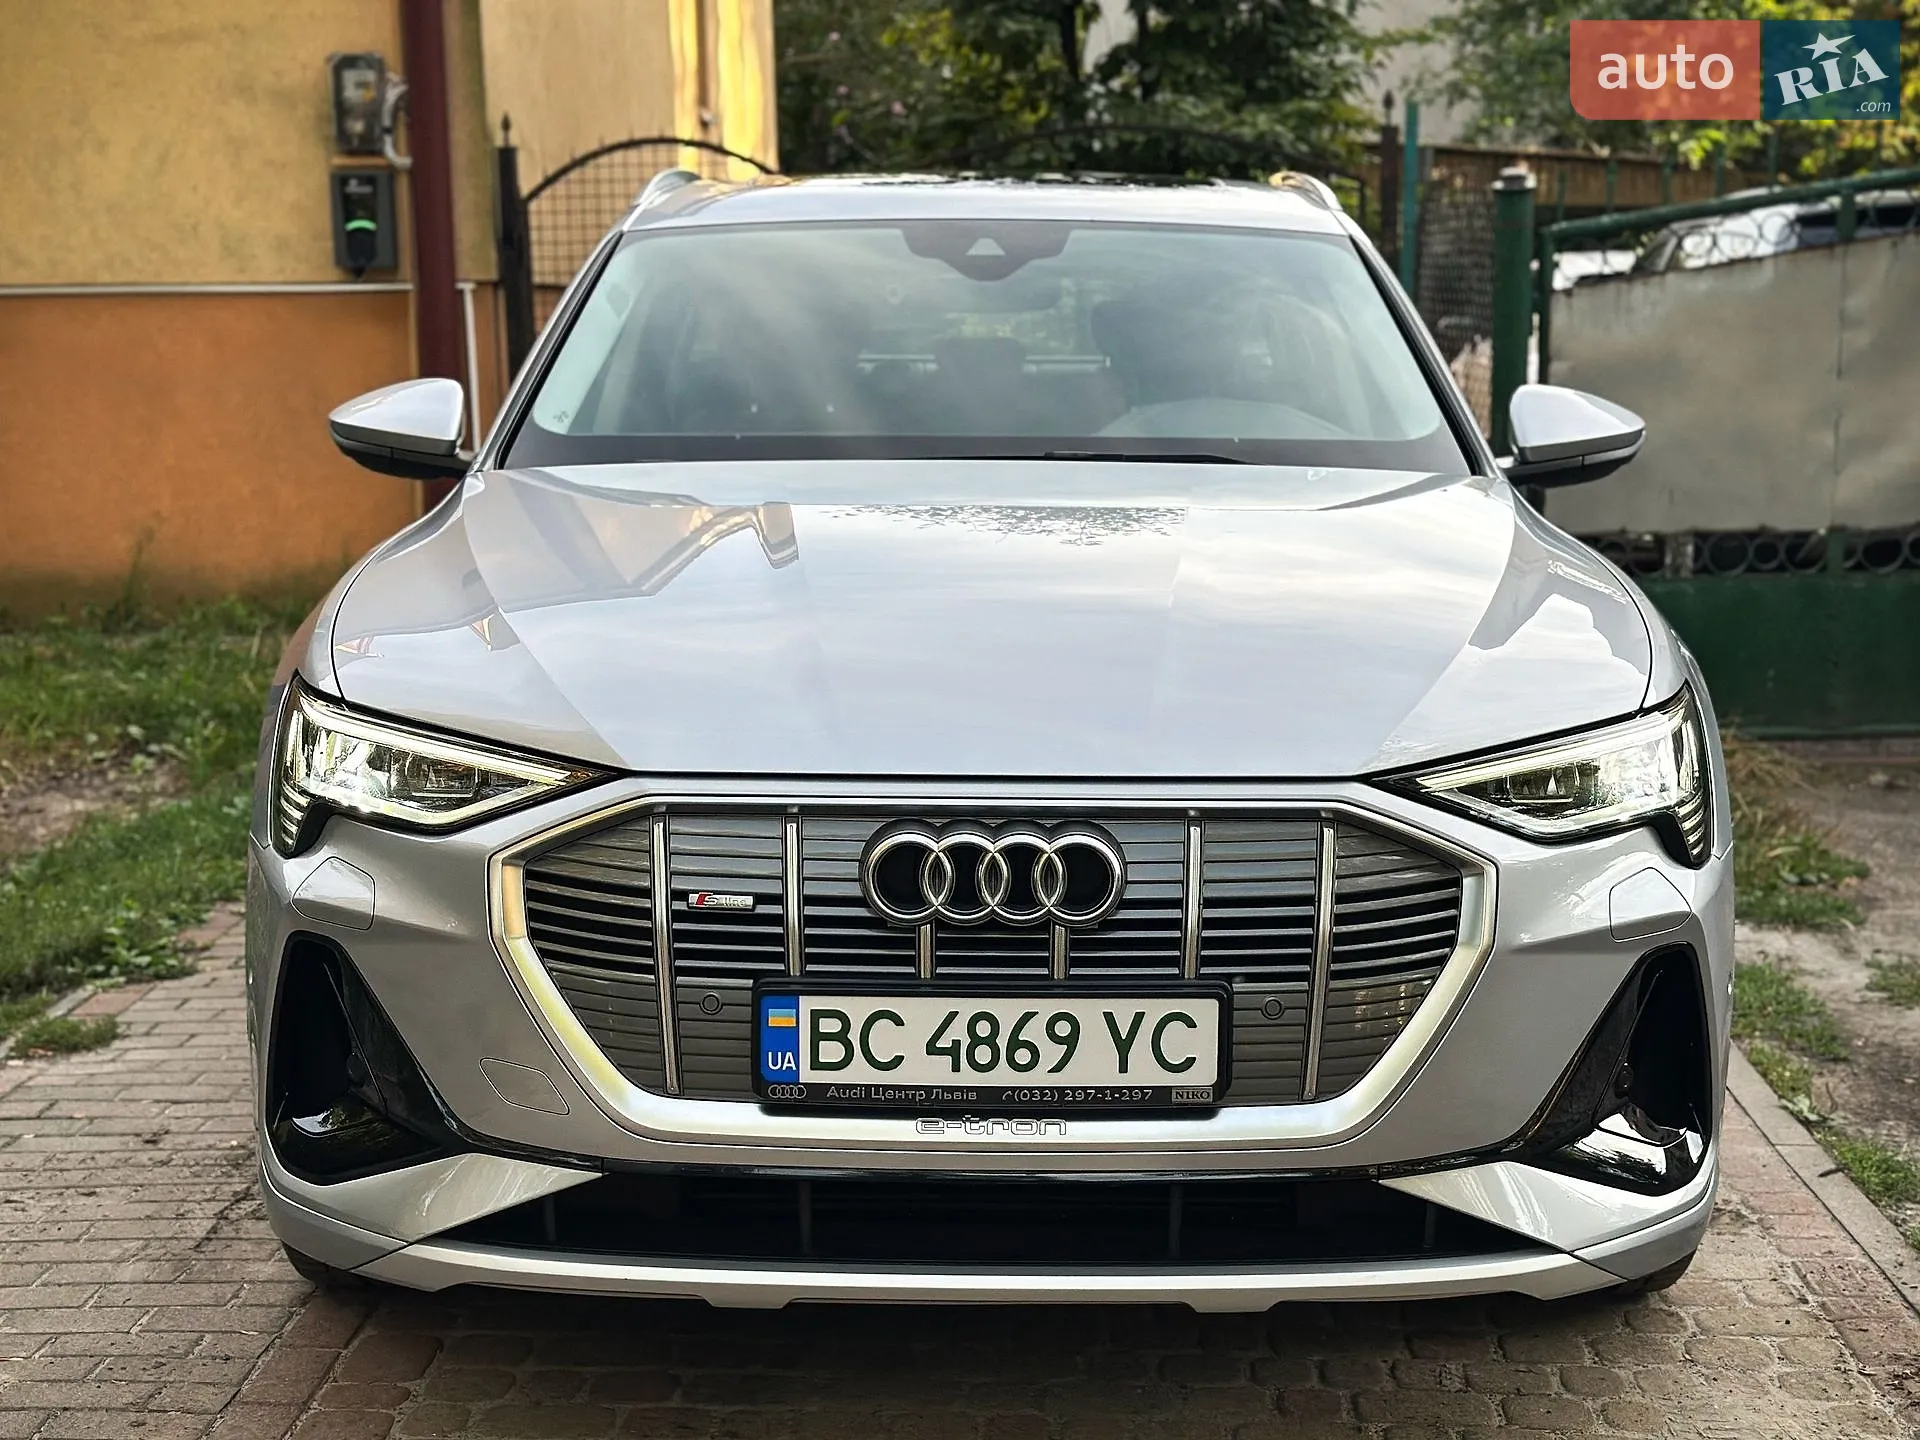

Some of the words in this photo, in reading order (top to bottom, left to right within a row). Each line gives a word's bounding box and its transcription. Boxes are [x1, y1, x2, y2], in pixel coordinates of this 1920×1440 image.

[810, 1009, 905, 1072] BC
[925, 1010, 1081, 1074] 4869
[1102, 1011, 1198, 1074] YC
[768, 1052, 797, 1072] UA
[826, 1087, 866, 1099] Audi
[871, 1088, 926, 1102] Центр
[930, 1088, 978, 1101] Львів
[1013, 1089, 1059, 1102] (032)
[1064, 1090, 1153, 1101] 297-1-297
[1174, 1090, 1211, 1101] NIKO
[915, 1115, 1067, 1136] e-tron
